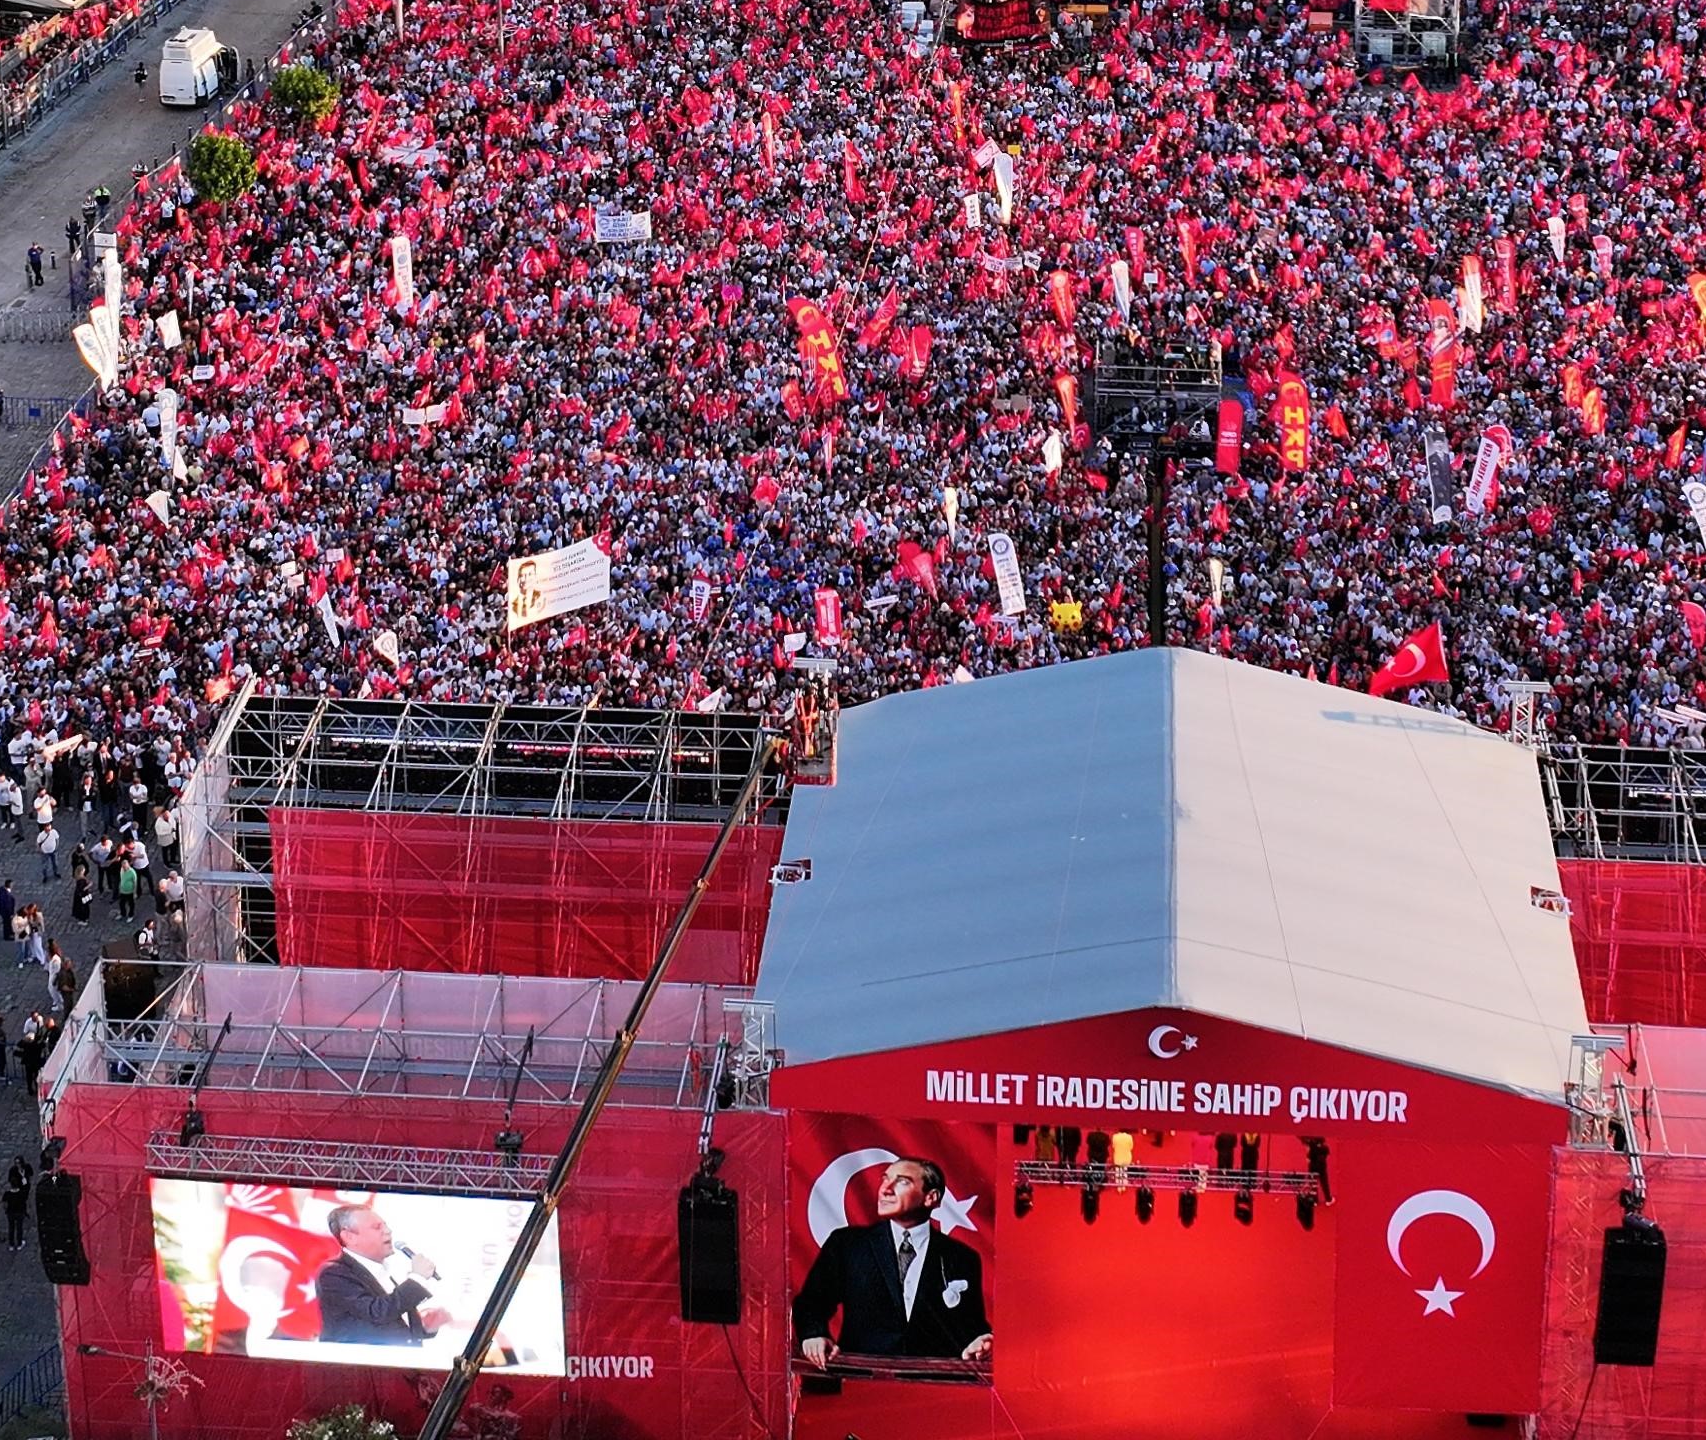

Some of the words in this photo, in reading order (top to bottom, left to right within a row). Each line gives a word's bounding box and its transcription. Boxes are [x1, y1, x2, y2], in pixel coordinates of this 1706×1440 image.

[926, 1070, 1029, 1105] MİLLET
[1036, 1075, 1185, 1113] İRADESİNE
[1194, 1081, 1282, 1117] SAHİP
[1289, 1086, 1408, 1124] ÇIKIYOR
[566, 1354, 655, 1382] ÇIKIYOR
